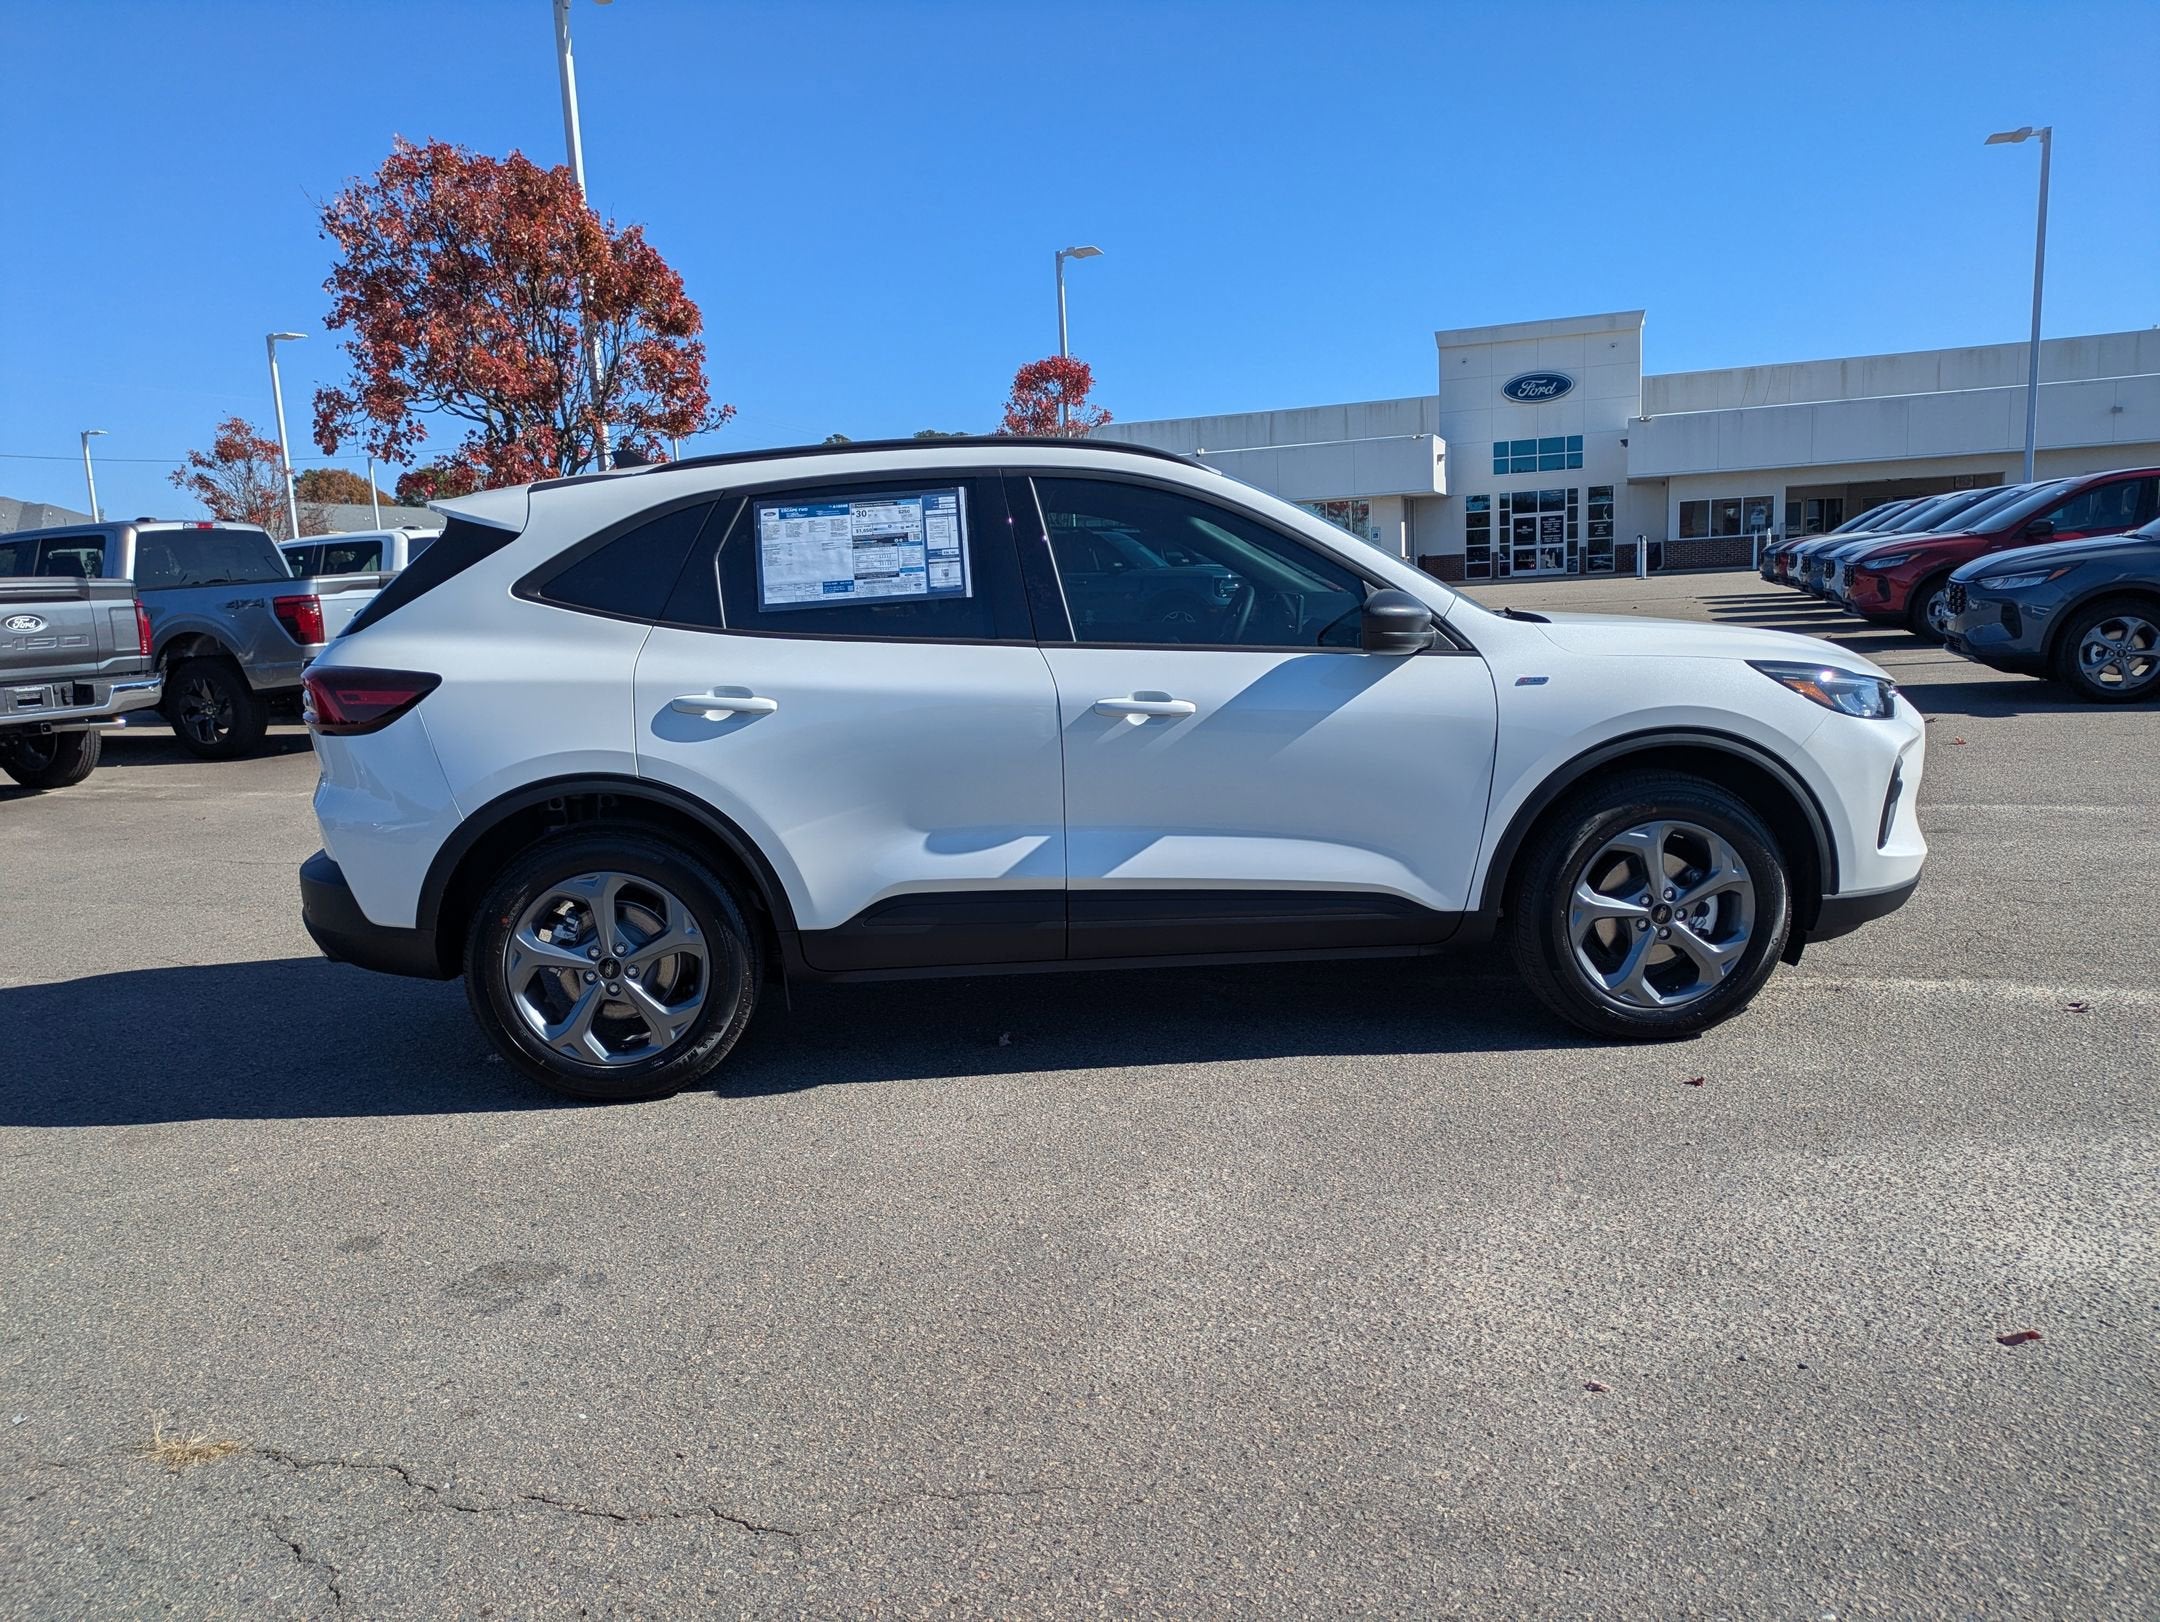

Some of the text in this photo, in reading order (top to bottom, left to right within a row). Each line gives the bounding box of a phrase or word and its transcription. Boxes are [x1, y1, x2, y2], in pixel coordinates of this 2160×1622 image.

[1517, 379, 1557, 397] Ford
[855, 509, 867, 518] 30
[11, 616, 37, 630] Ford
